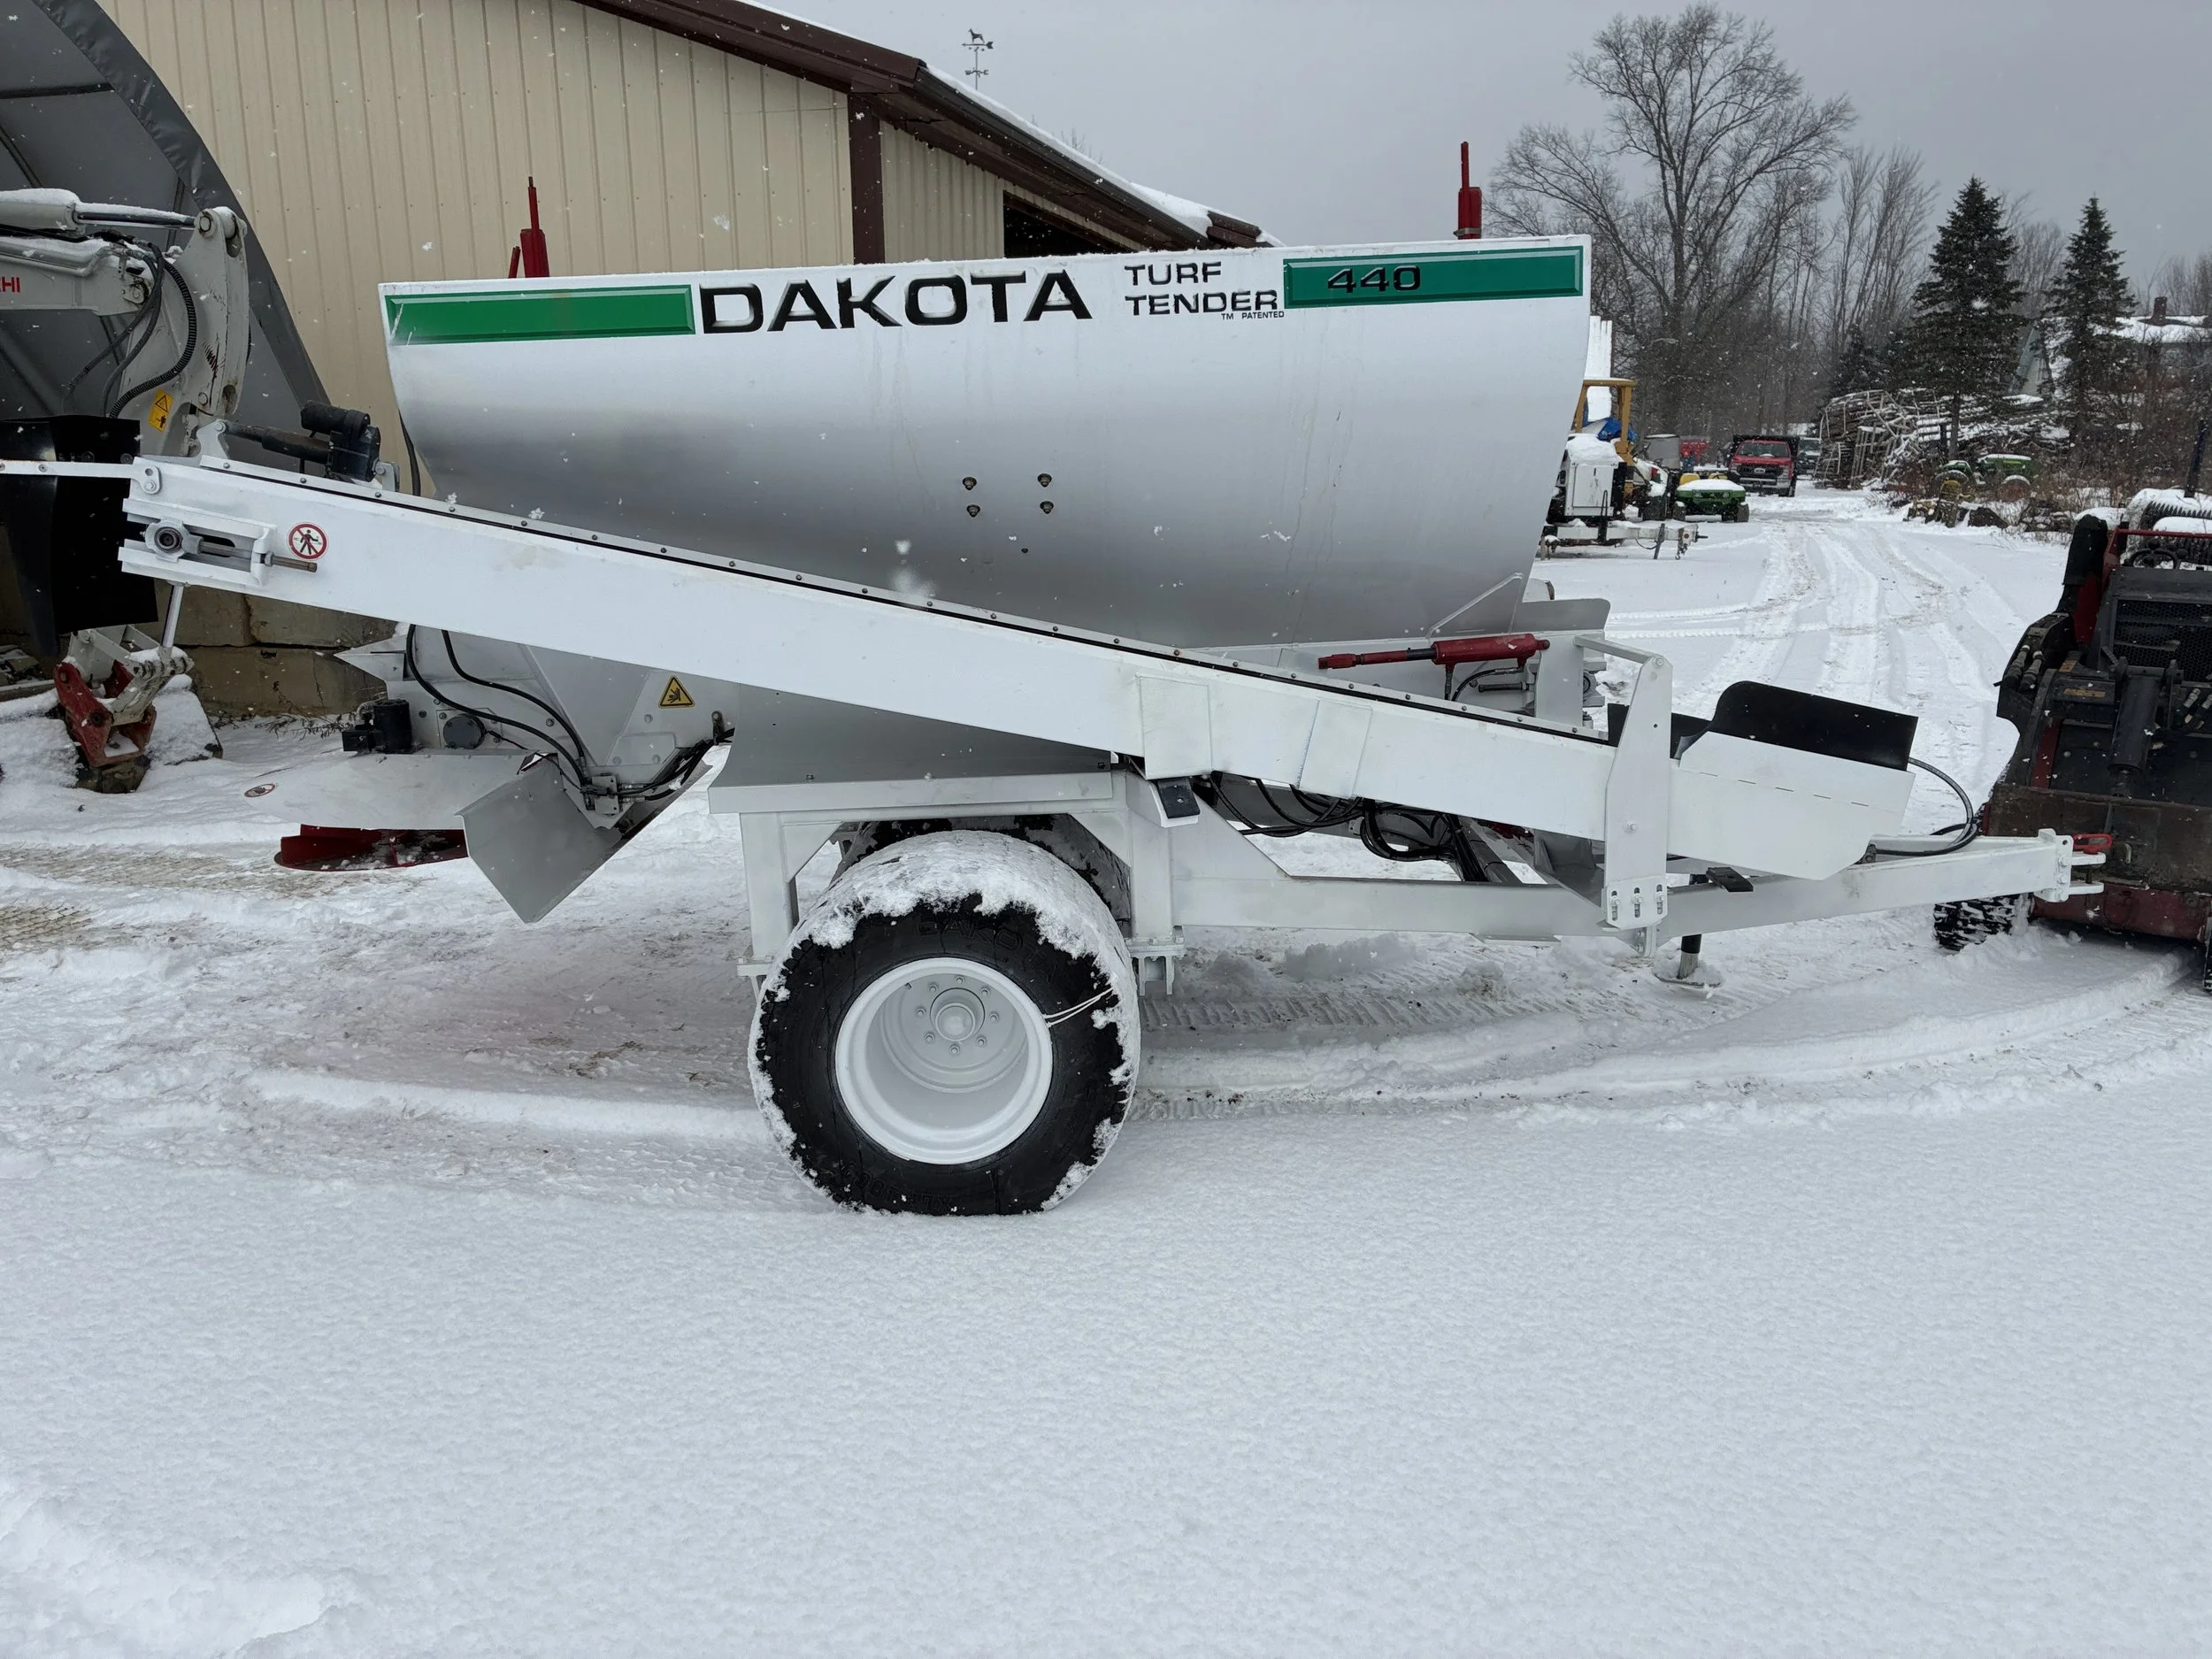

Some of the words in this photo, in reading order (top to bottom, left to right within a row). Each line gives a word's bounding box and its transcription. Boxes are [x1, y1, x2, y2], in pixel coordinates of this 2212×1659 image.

[0, 276, 20, 293] HI
[1124, 261, 1222, 286] TURF
[1327, 265, 1421, 294] 440
[699, 269, 1093, 334] DAKOTA
[1125, 289, 1278, 316] TENDER
[1221, 312, 1234, 321] TM
[1241, 311, 1285, 320] PATENTED
